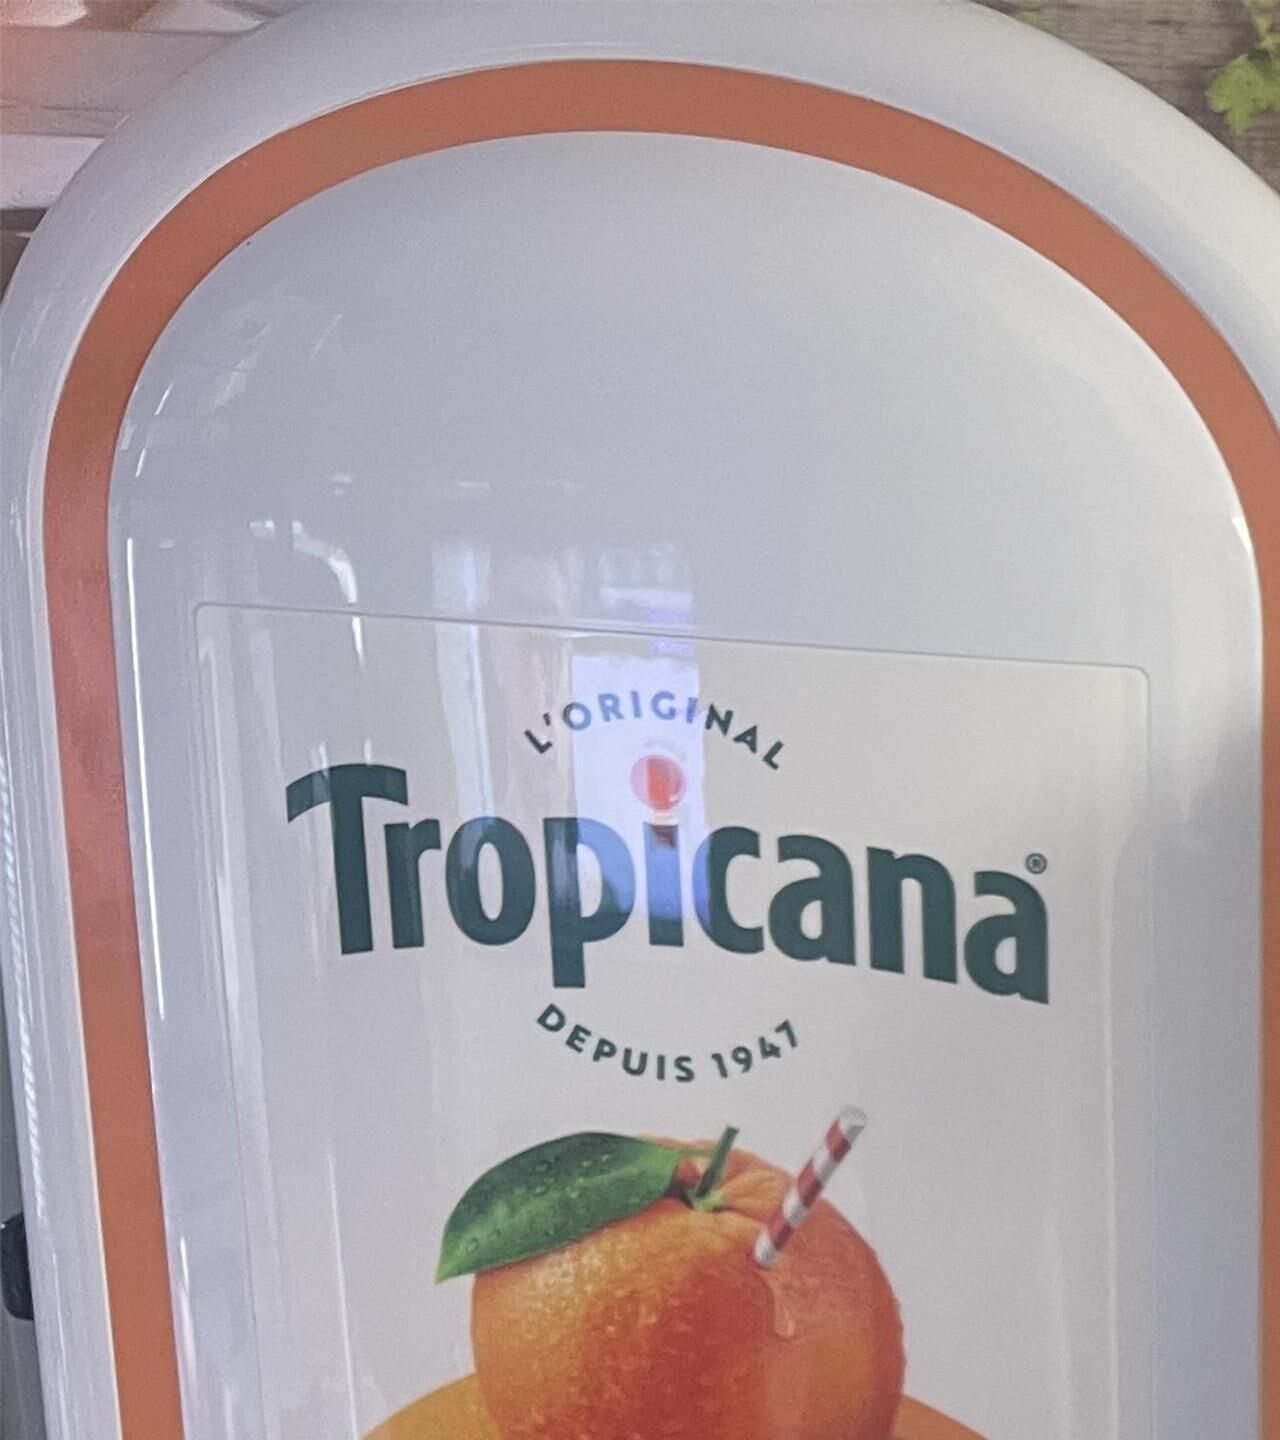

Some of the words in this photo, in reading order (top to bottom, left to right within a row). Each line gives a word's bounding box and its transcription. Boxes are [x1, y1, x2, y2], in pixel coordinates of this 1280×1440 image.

[525, 690, 784, 770] L'ORIGINAL
[536, 1003, 695, 1082] DEPUIS
[711, 1019, 798, 1078] 1947
